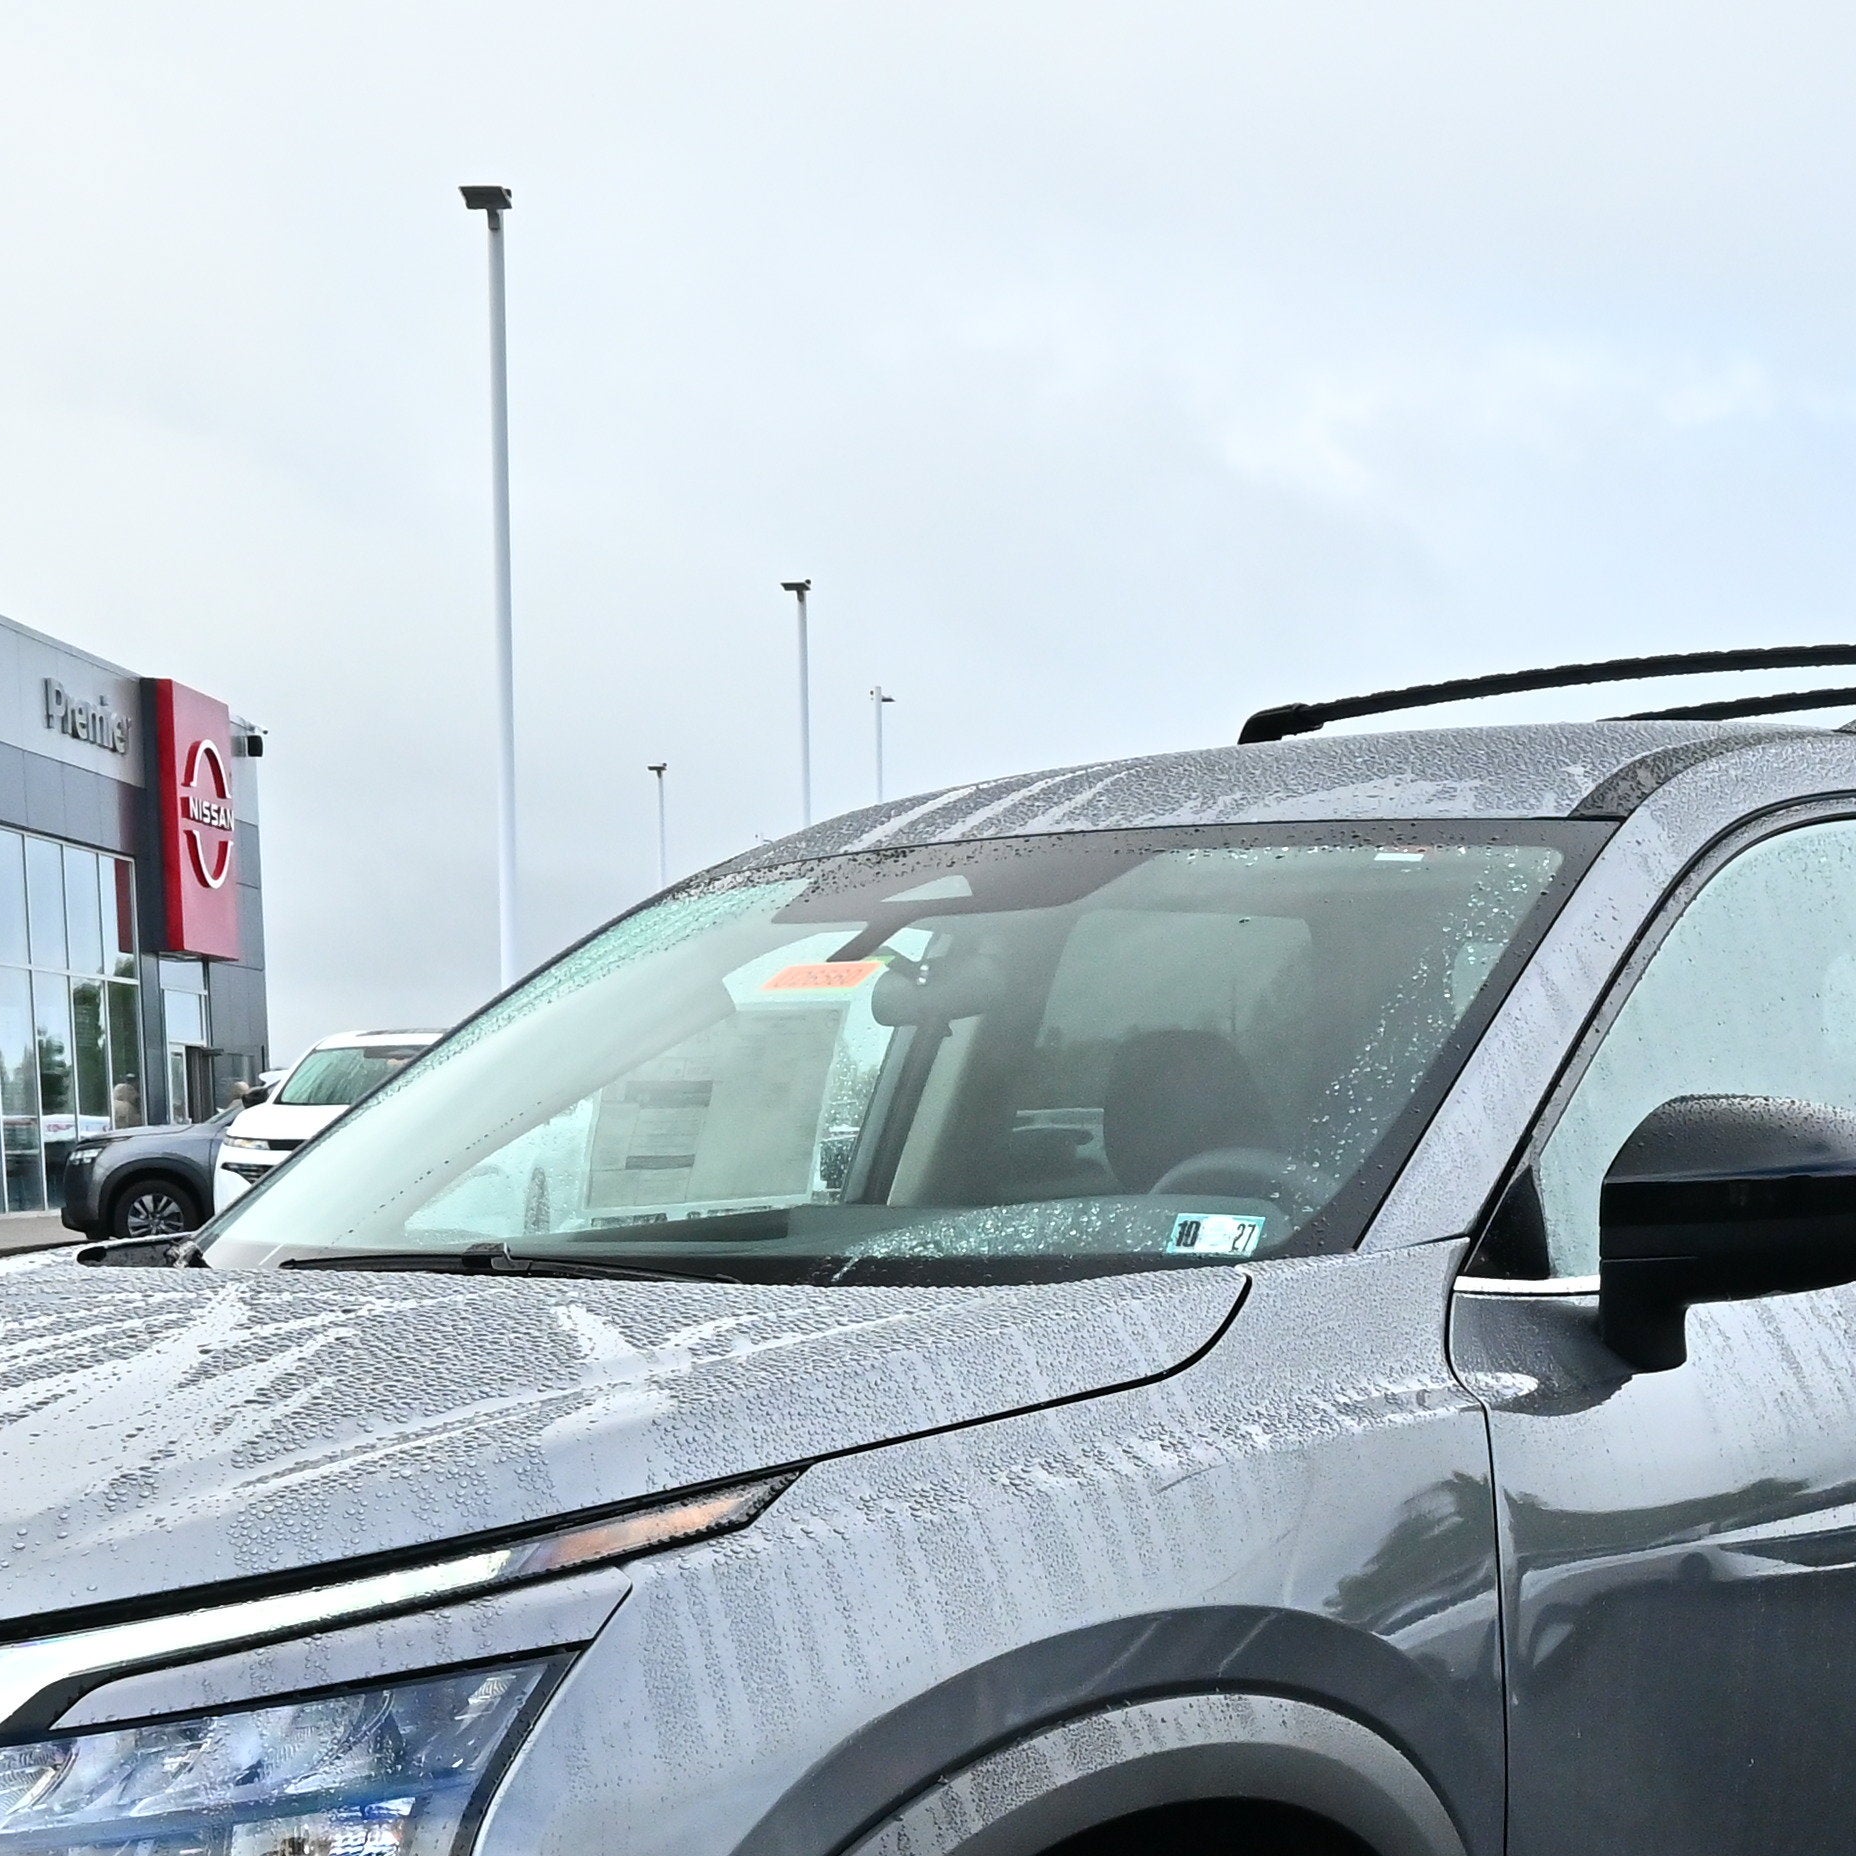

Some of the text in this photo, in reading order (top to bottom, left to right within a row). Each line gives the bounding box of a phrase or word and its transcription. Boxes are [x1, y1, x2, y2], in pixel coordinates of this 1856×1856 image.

[43, 677, 132, 755] Premier
[188, 796, 236, 831] NISSAN
[1175, 1219, 1257, 1253] 10 27
